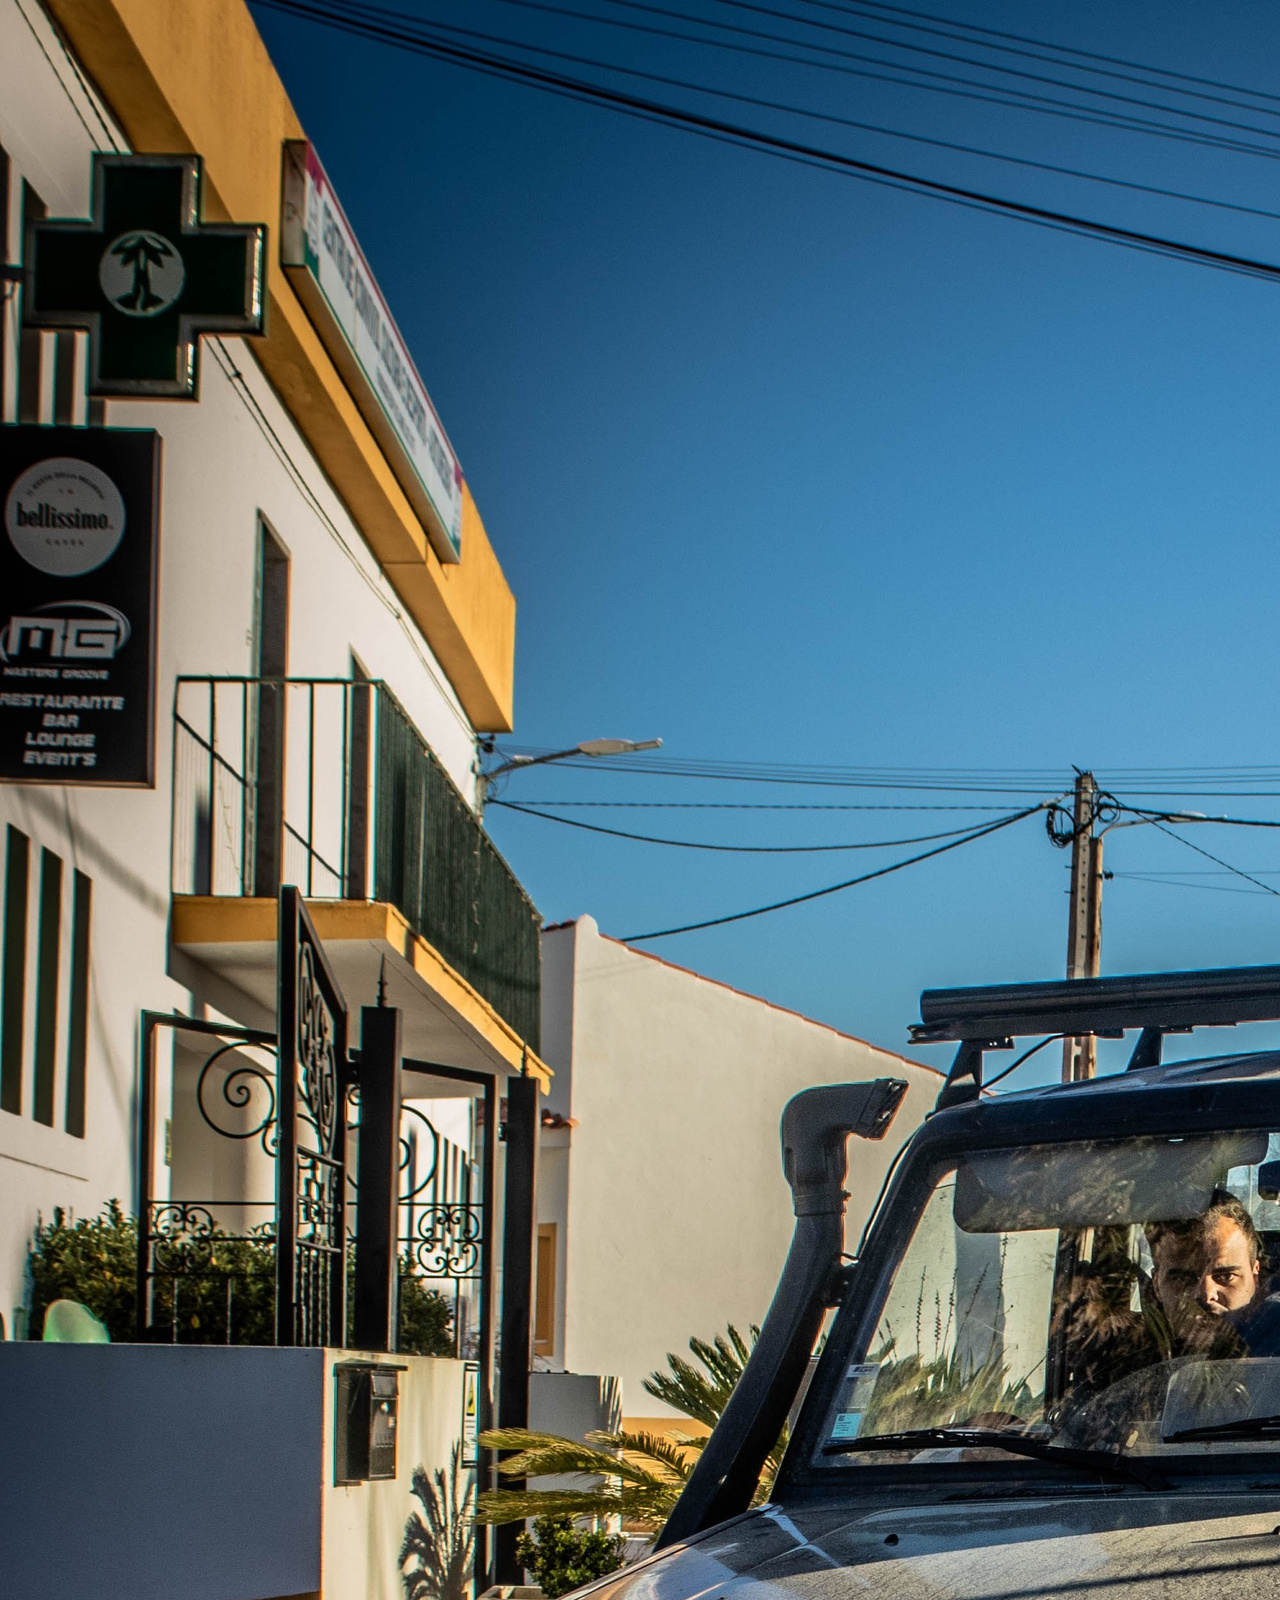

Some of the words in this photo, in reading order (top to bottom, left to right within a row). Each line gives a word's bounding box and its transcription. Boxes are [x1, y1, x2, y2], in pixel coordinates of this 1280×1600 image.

[16, 500, 109, 530] bellissimo
[0, 693, 125, 710] RESTAURANTE
[42, 713, 80, 728] BAR
[25, 731, 96, 747] LOUNGE
